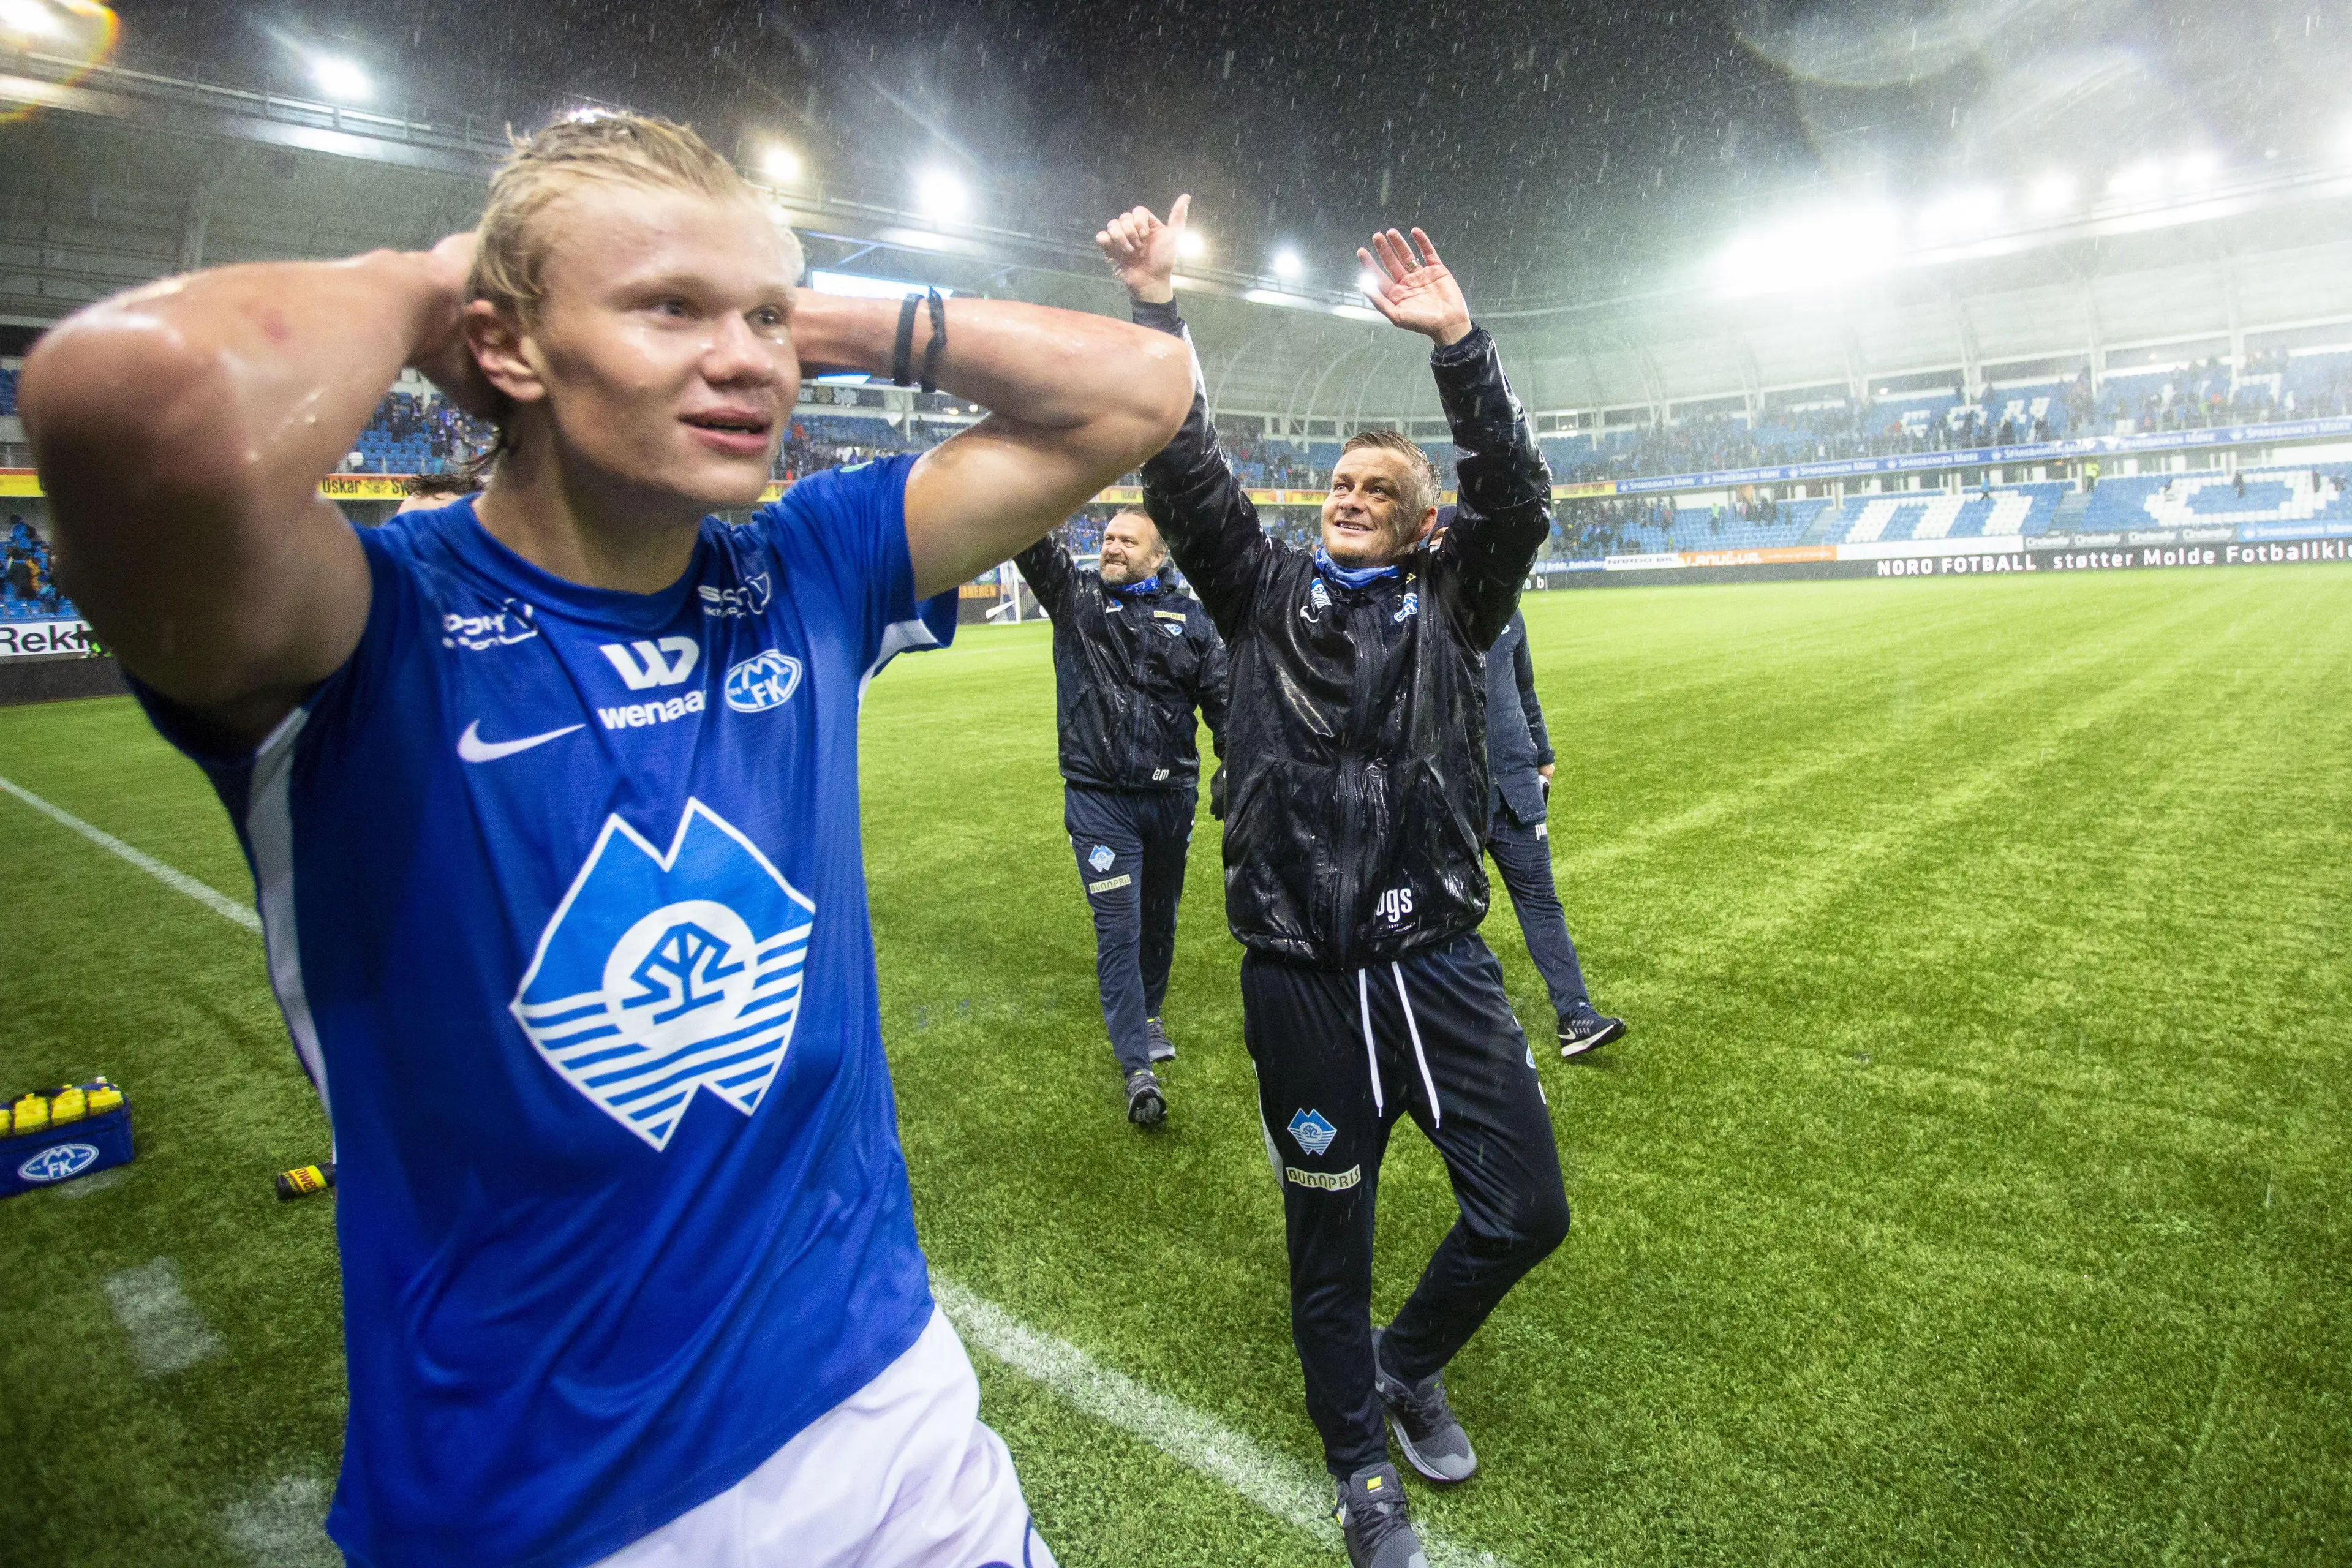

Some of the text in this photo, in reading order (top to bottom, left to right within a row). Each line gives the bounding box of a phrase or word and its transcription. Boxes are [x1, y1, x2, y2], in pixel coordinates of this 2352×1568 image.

[1942, 554, 2037, 575] FOTBALL
[2053, 551, 2133, 570] støtter
[2144, 547, 2217, 567] Molde
